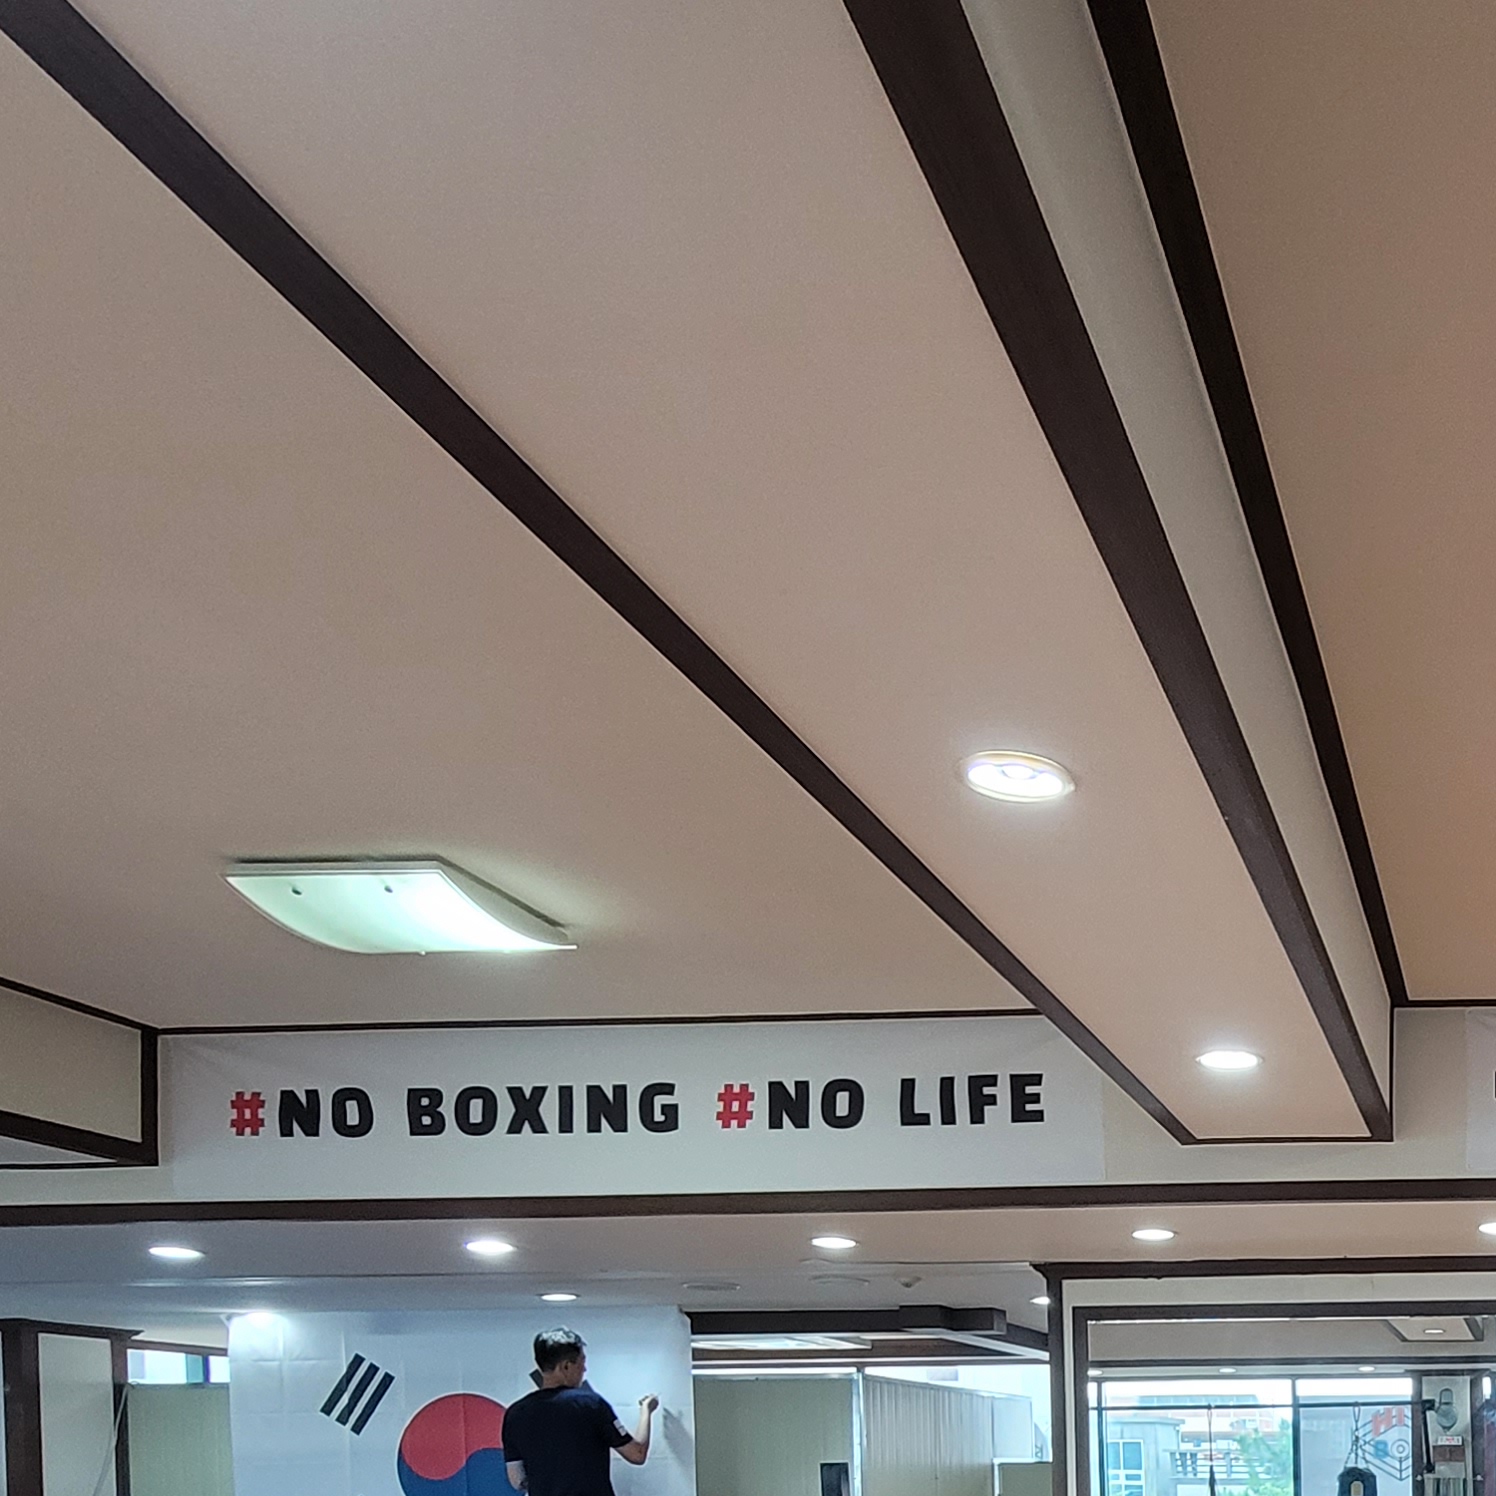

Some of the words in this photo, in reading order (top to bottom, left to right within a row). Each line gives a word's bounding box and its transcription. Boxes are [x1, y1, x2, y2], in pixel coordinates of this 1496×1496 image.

[230, 1086, 374, 1138] #NO
[407, 1082, 680, 1137] BOXING
[715, 1078, 865, 1130] #NO
[898, 1073, 1045, 1126] LIFE
[1372, 1407, 1405, 1438] HI
[1374, 1439, 1410, 1461] BO
